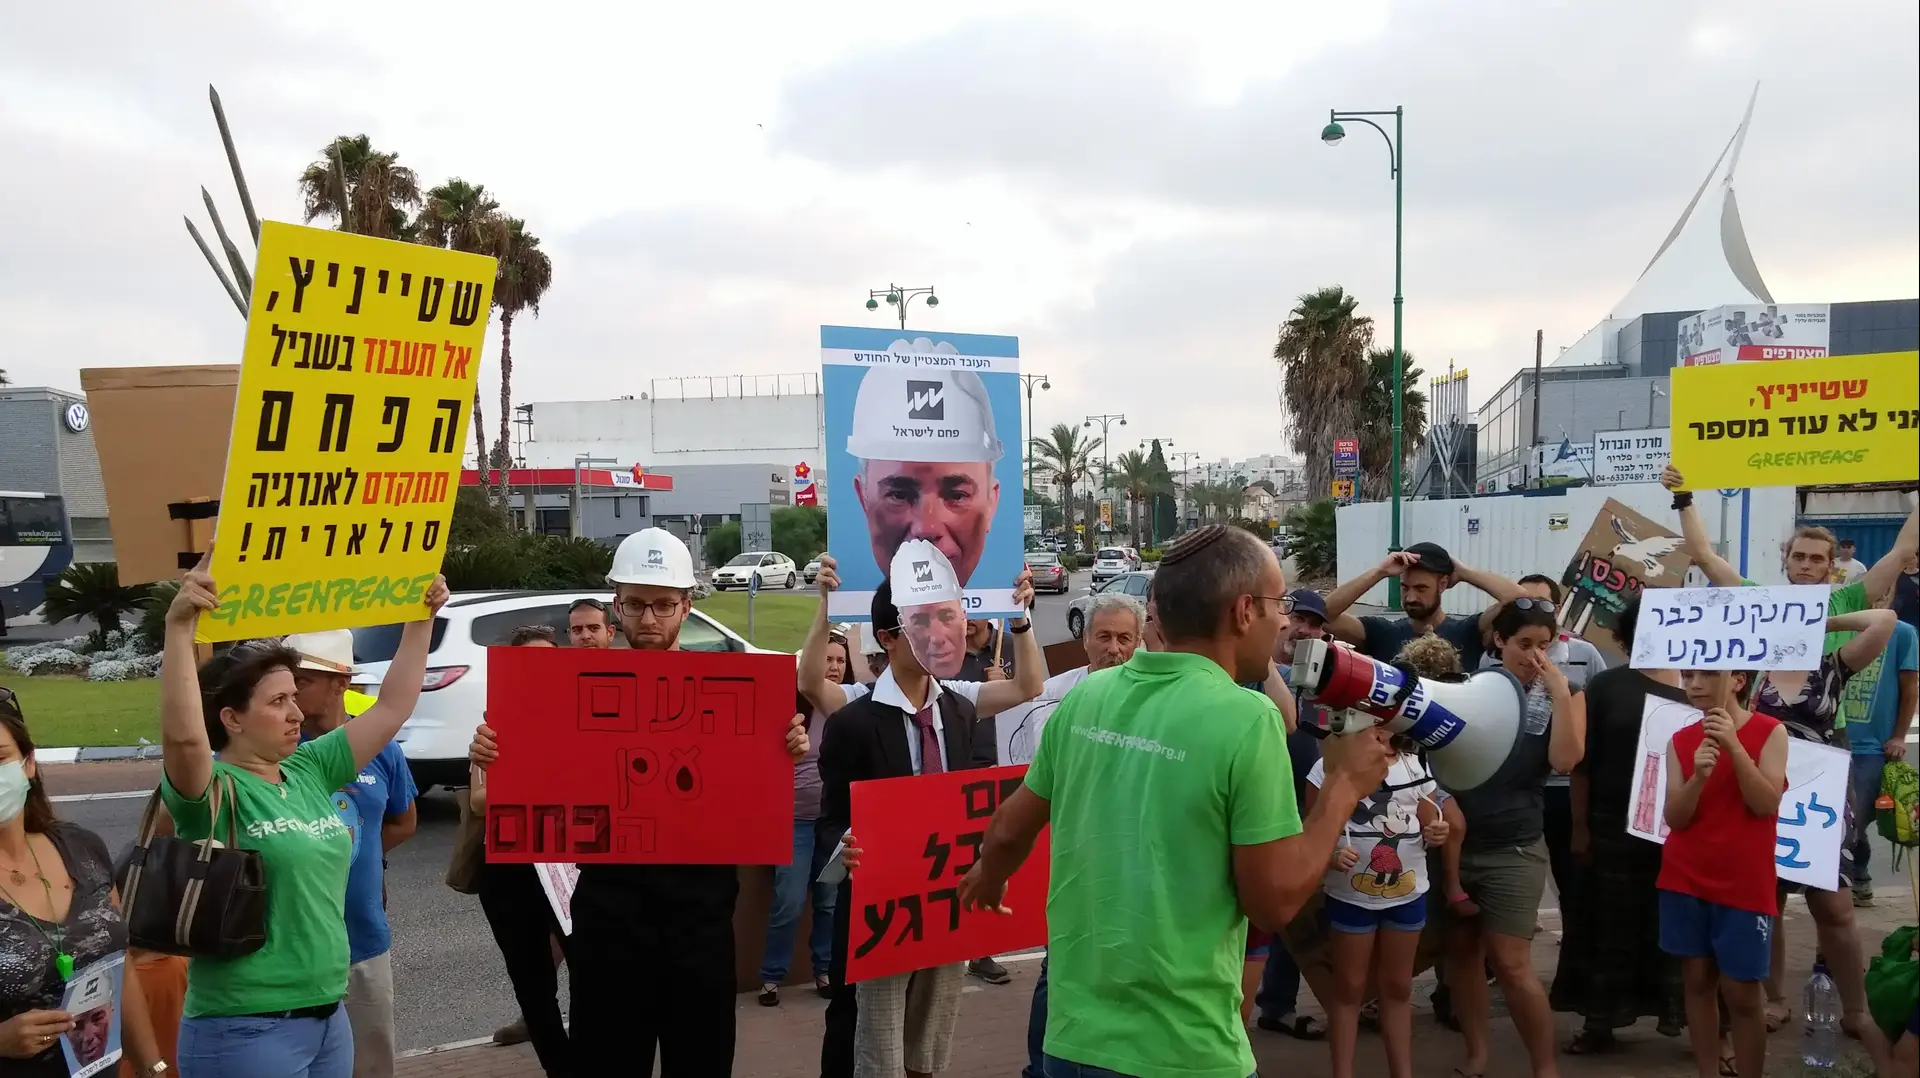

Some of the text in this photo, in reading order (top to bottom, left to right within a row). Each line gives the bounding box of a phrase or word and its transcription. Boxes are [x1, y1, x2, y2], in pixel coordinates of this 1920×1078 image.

[266, 256, 483, 326] שטייניץ,
[271, 324, 472, 379] אל תעבוד בשביל
[854, 353, 991, 368] העובד המצטיין של החודש
[1749, 379, 1868, 410] שטייניץ,
[893, 425, 960, 438] פחם לישראל
[1689, 418, 1769, 441] מספר
[1779, 414, 1828, 435] עוד
[1838, 408, 1877, 433] לא
[1600, 436, 1662, 451] מרכז הברזל
[1614, 463, 1654, 472] גדר לבנה
[1747, 449, 1869, 469] GREENPEACE
[247, 467, 450, 508] תתקדם לאנרגיה
[238, 518, 440, 562] סולארית!
[208, 572, 435, 626] GREENPEACE
[1651, 602, 1824, 633] נחנקנו כבר
[1668, 638, 1768, 665] נחנקנו
[577, 672, 755, 735] העם
[489, 804, 656, 854] הפחם
[854, 887, 960, 960] רגע
[98, 1056, 112, 1068] פחם
